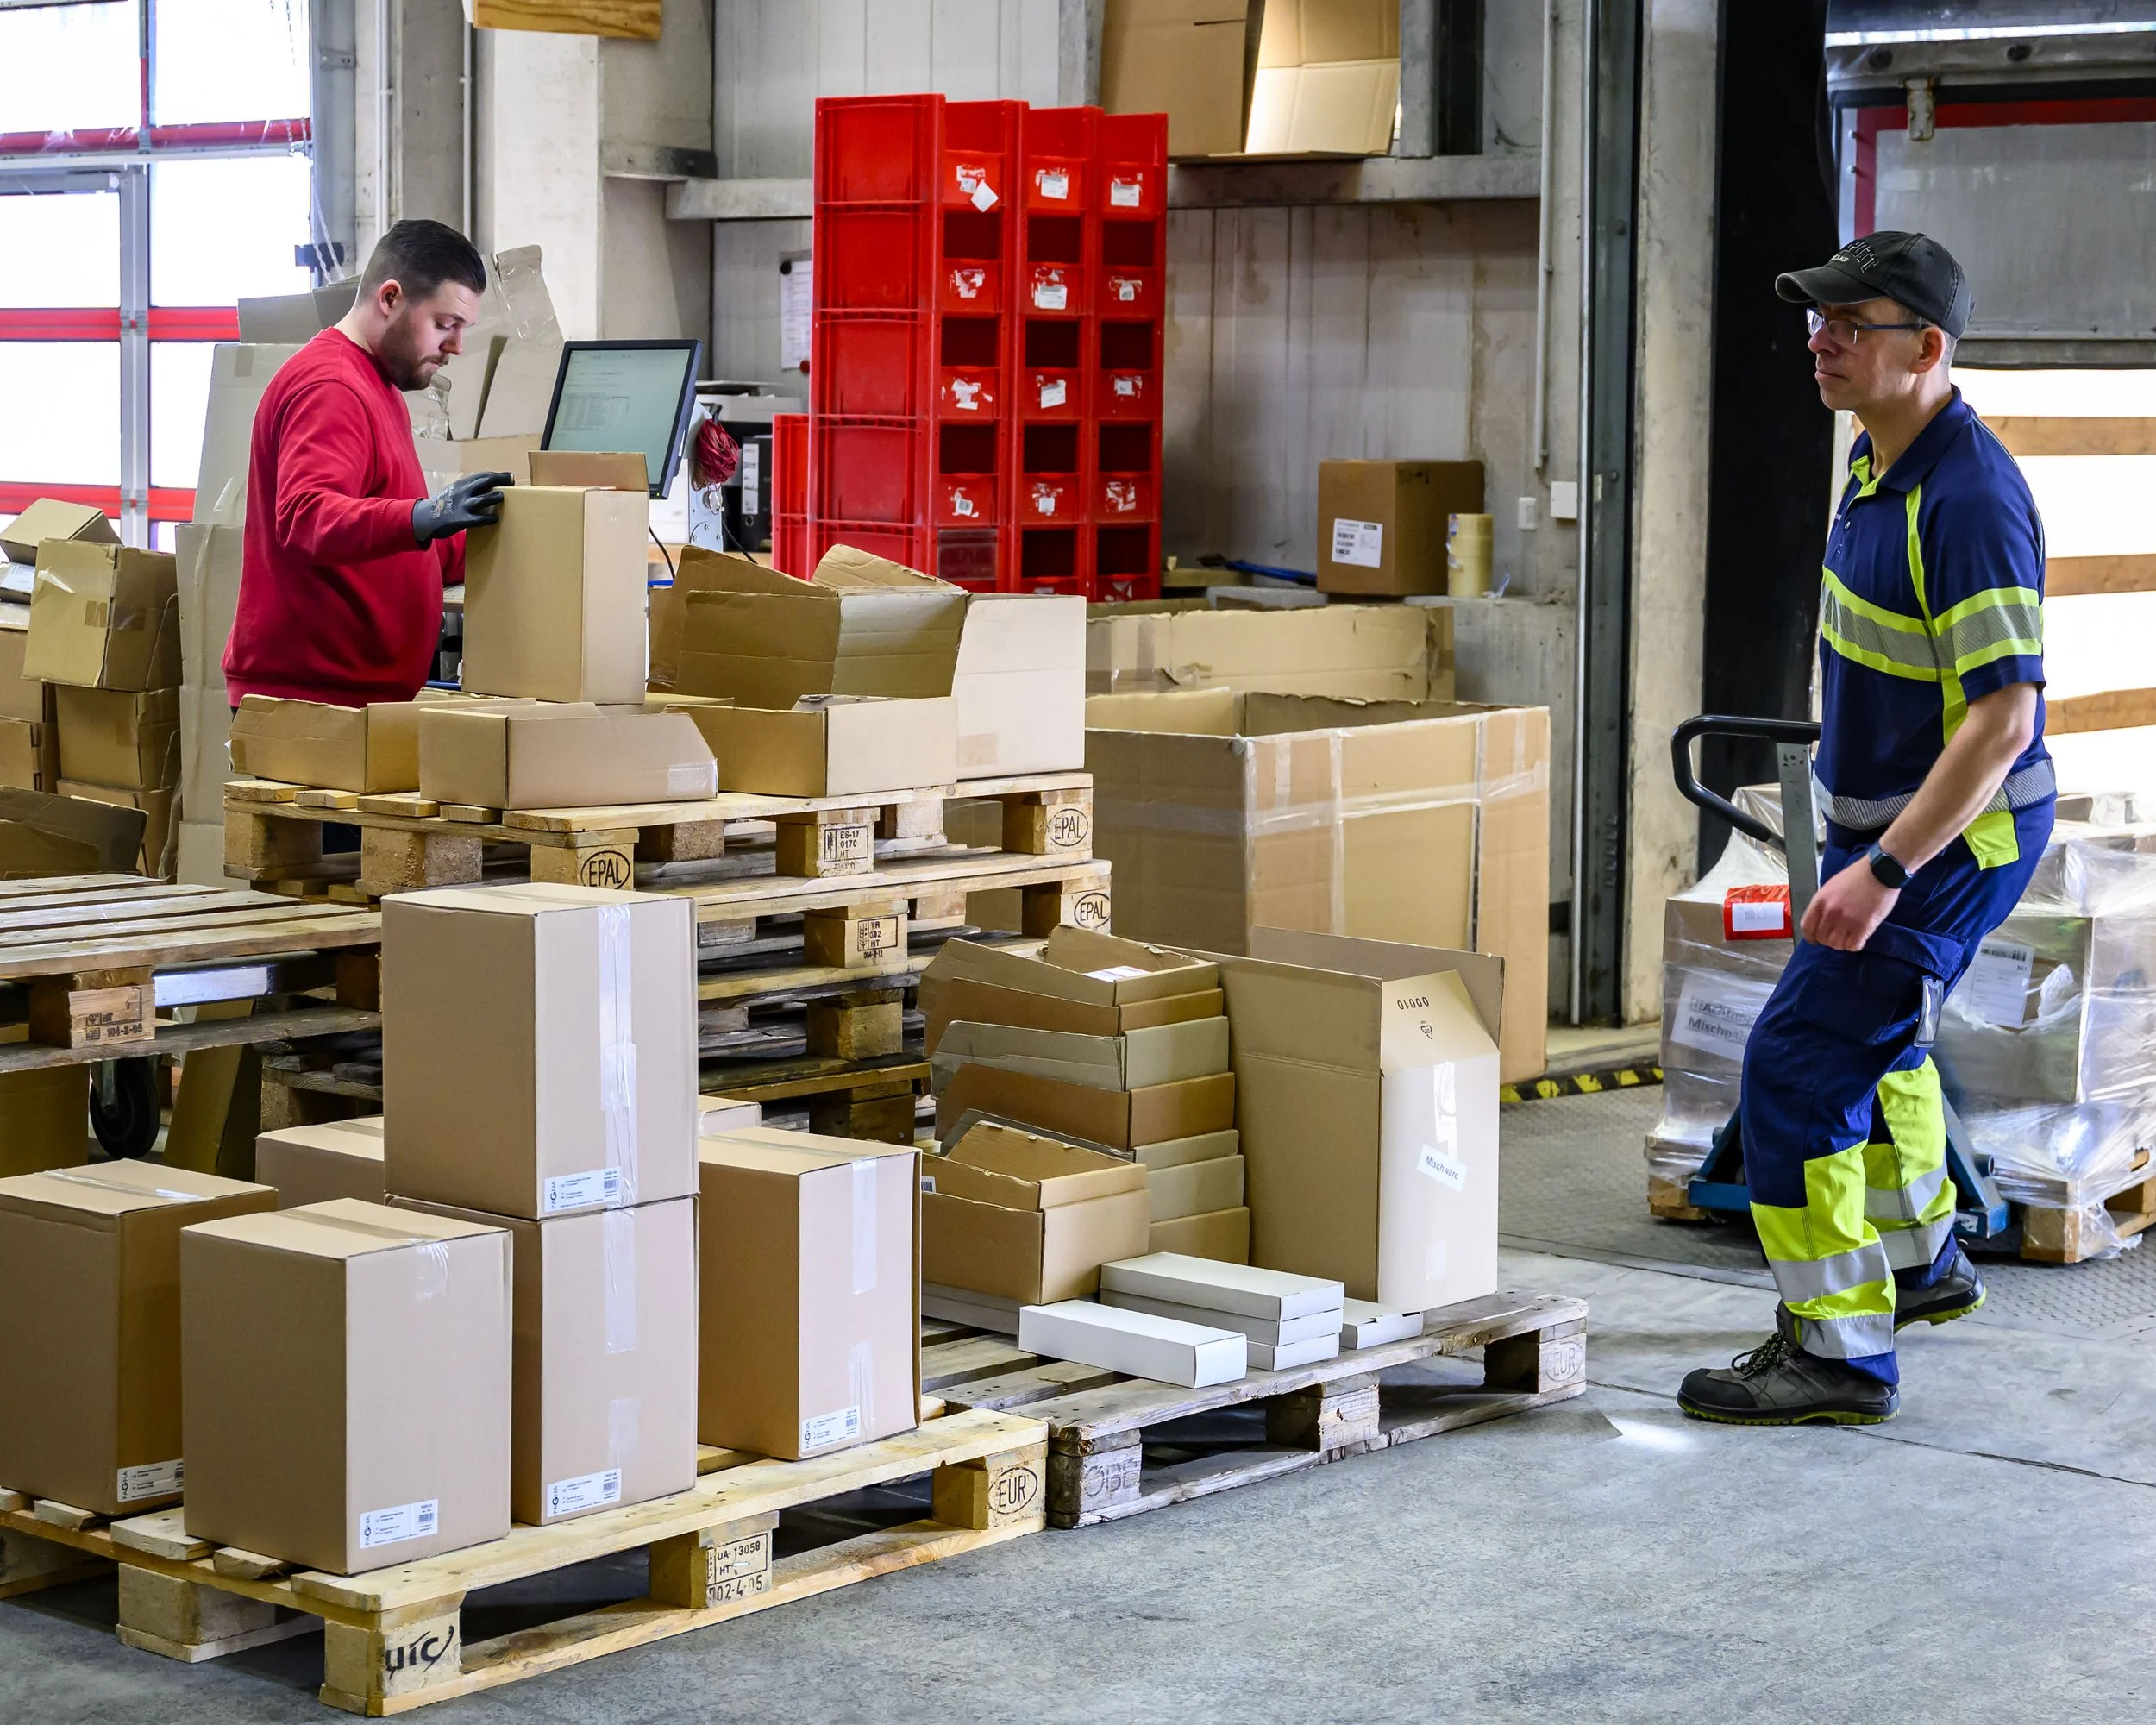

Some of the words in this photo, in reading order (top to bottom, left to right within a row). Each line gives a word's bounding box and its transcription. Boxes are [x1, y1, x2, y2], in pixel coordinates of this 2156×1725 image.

[840, 831, 860, 839] ES-17
[1055, 816, 1081, 839] EPAL
[840, 839, 857, 848] 0170
[589, 858, 622, 887] EPAL
[1080, 900, 1107, 921] EPAL
[1426, 1156, 1459, 1180] Mischware
[998, 1475, 1025, 1508] EUR
[719, 1564, 730, 1575] HT
